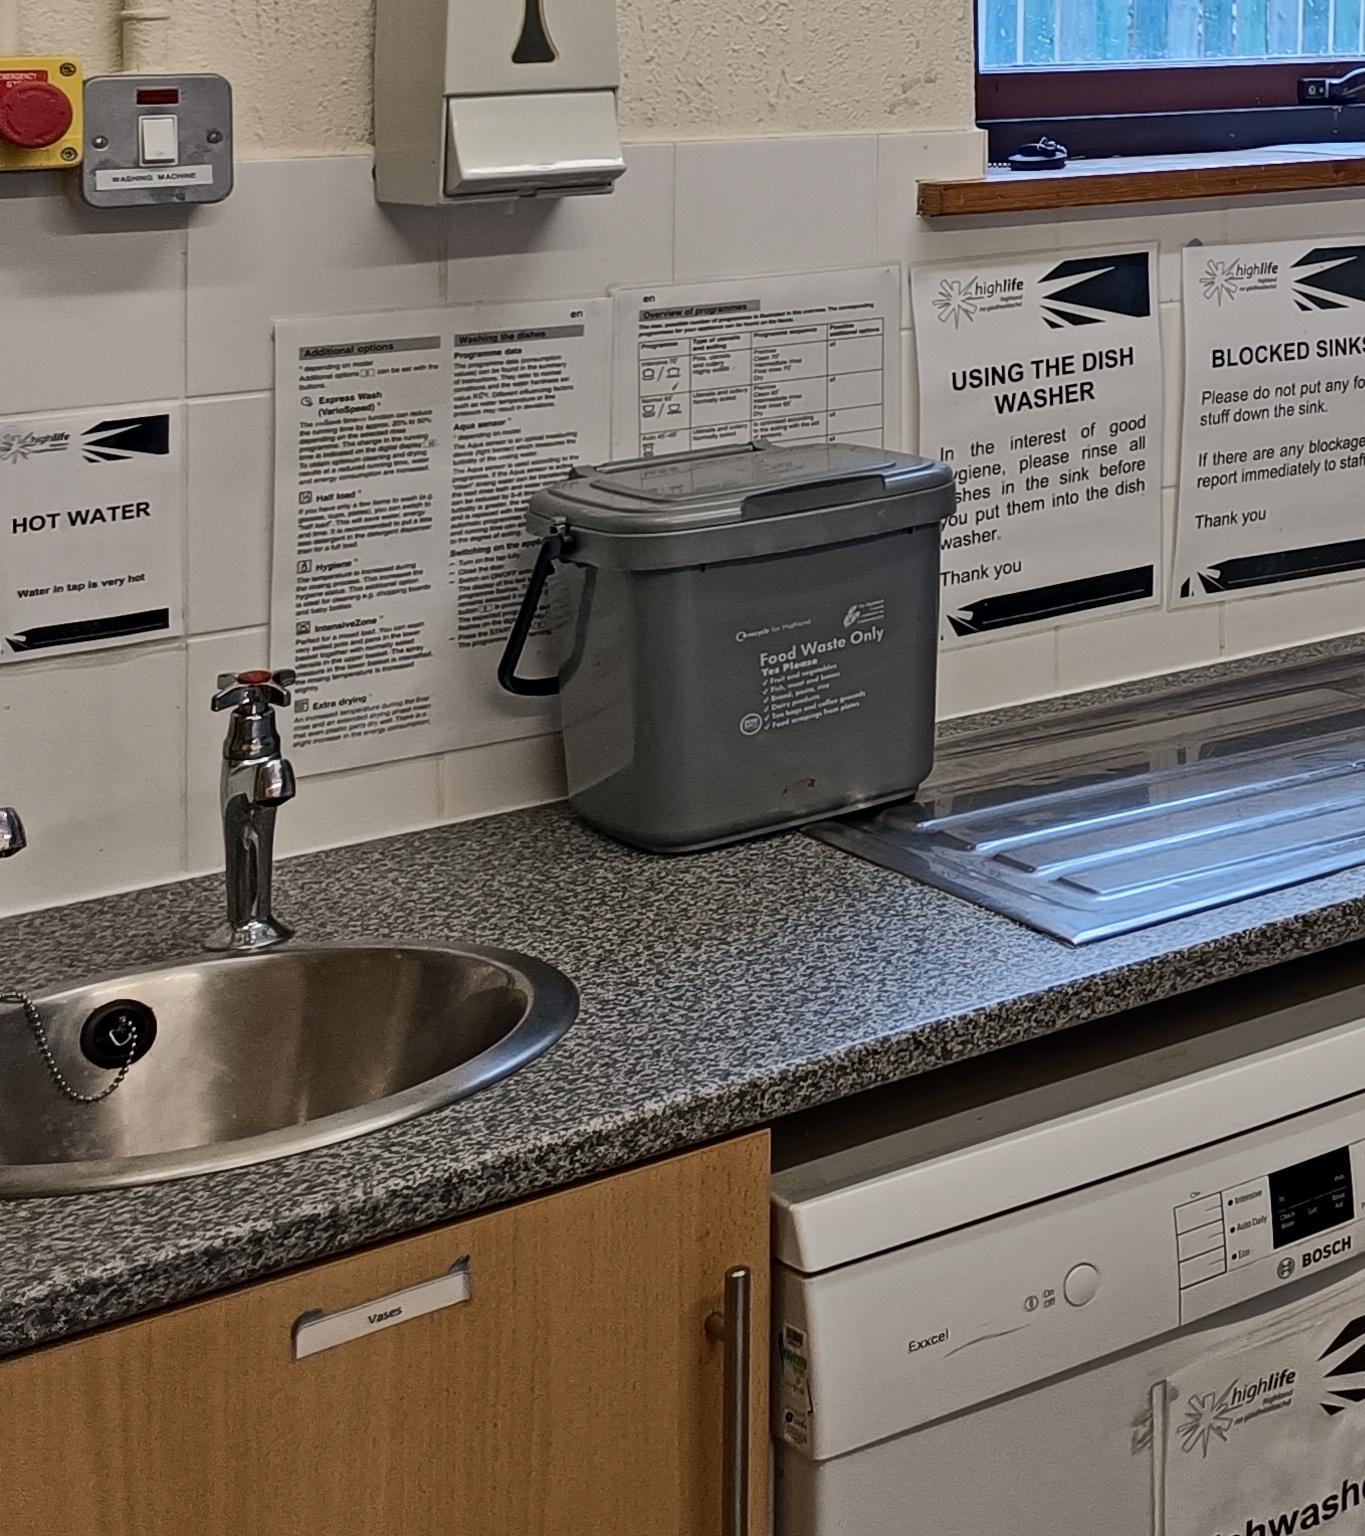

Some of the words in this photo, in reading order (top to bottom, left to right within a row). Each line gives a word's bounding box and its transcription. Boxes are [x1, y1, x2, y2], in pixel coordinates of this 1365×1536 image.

[112, 173, 154, 183] WASHING
[157, 171, 197, 181] MACHINE
[1236, 261, 1279, 279] highlife
[974, 277, 1024, 298] highlife
[643, 295, 655, 303] en
[570, 310, 583, 319] en
[643, 307, 686, 320] Overview
[687, 306, 696, 314] of
[696, 302, 747, 316] programmes
[304, 344, 355, 358] Additional
[357, 341, 394, 355] options
[1211, 340, 1310, 368] BLOCKED
[951, 362, 1025, 391] USING
[1030, 354, 1075, 382] THE
[1082, 346, 1135, 373] DISH
[319, 393, 356, 405] Express
[357, 390, 383, 401] Wash
[994, 381, 1096, 415] WASHER
[1201, 387, 1249, 406] Please
[1252, 385, 1271, 400] do
[1274, 382, 1296, 398] not
[1299, 379, 1322, 400] put
[1325, 377, 1350, 396] any
[318, 403, 376, 417] (VarioSpeed)
[939, 446, 954, 462] In
[970, 441, 995, 458] the
[1009, 428, 1067, 451] interest
[1080, 422, 1097, 439] of
[1109, 414, 1147, 438] good
[1196, 472, 1238, 490] report
[1241, 461, 1321, 484] immediately
[1324, 459, 1336, 473] to
[939, 509, 968, 532] you
[975, 505, 1001, 526] put
[1006, 497, 1045, 517] them
[1051, 491, 1079, 508] into
[1085, 485, 1109, 502] the
[1114, 478, 1146, 497] dish
[12, 512, 61, 534] HOT
[67, 501, 151, 527] WATER
[1195, 511, 1238, 530] Thank
[1241, 507, 1268, 527] you
[939, 527, 1002, 551] washer.
[939, 565, 990, 588] Thank
[993, 559, 1022, 580] you
[17, 586, 51, 599] Water
[53, 583, 64, 593] in
[67, 581, 86, 594] tap
[88, 580, 98, 590] is
[101, 577, 126, 589] very
[128, 573, 146, 584] hot
[314, 617, 378, 632] IntensiveZone
[760, 645, 797, 667] Food
[801, 636, 847, 657] Waste
[850, 625, 885, 645] Only
[761, 666, 780, 677] Yes
[783, 659, 818, 673] Please
[312, 699, 337, 712] Extra
[339, 695, 367, 708] drying
[1234, 1189, 1263, 1205] Intensive
[1253, 1214, 1268, 1229] Daily
[1238, 1248, 1250, 1259] Eco
[1302, 1236, 1352, 1268] BOSCH
[368, 1306, 403, 1325] Vases
[907, 1327, 950, 1353] Exxcel
[1230, 1367, 1297, 1406] highlife
